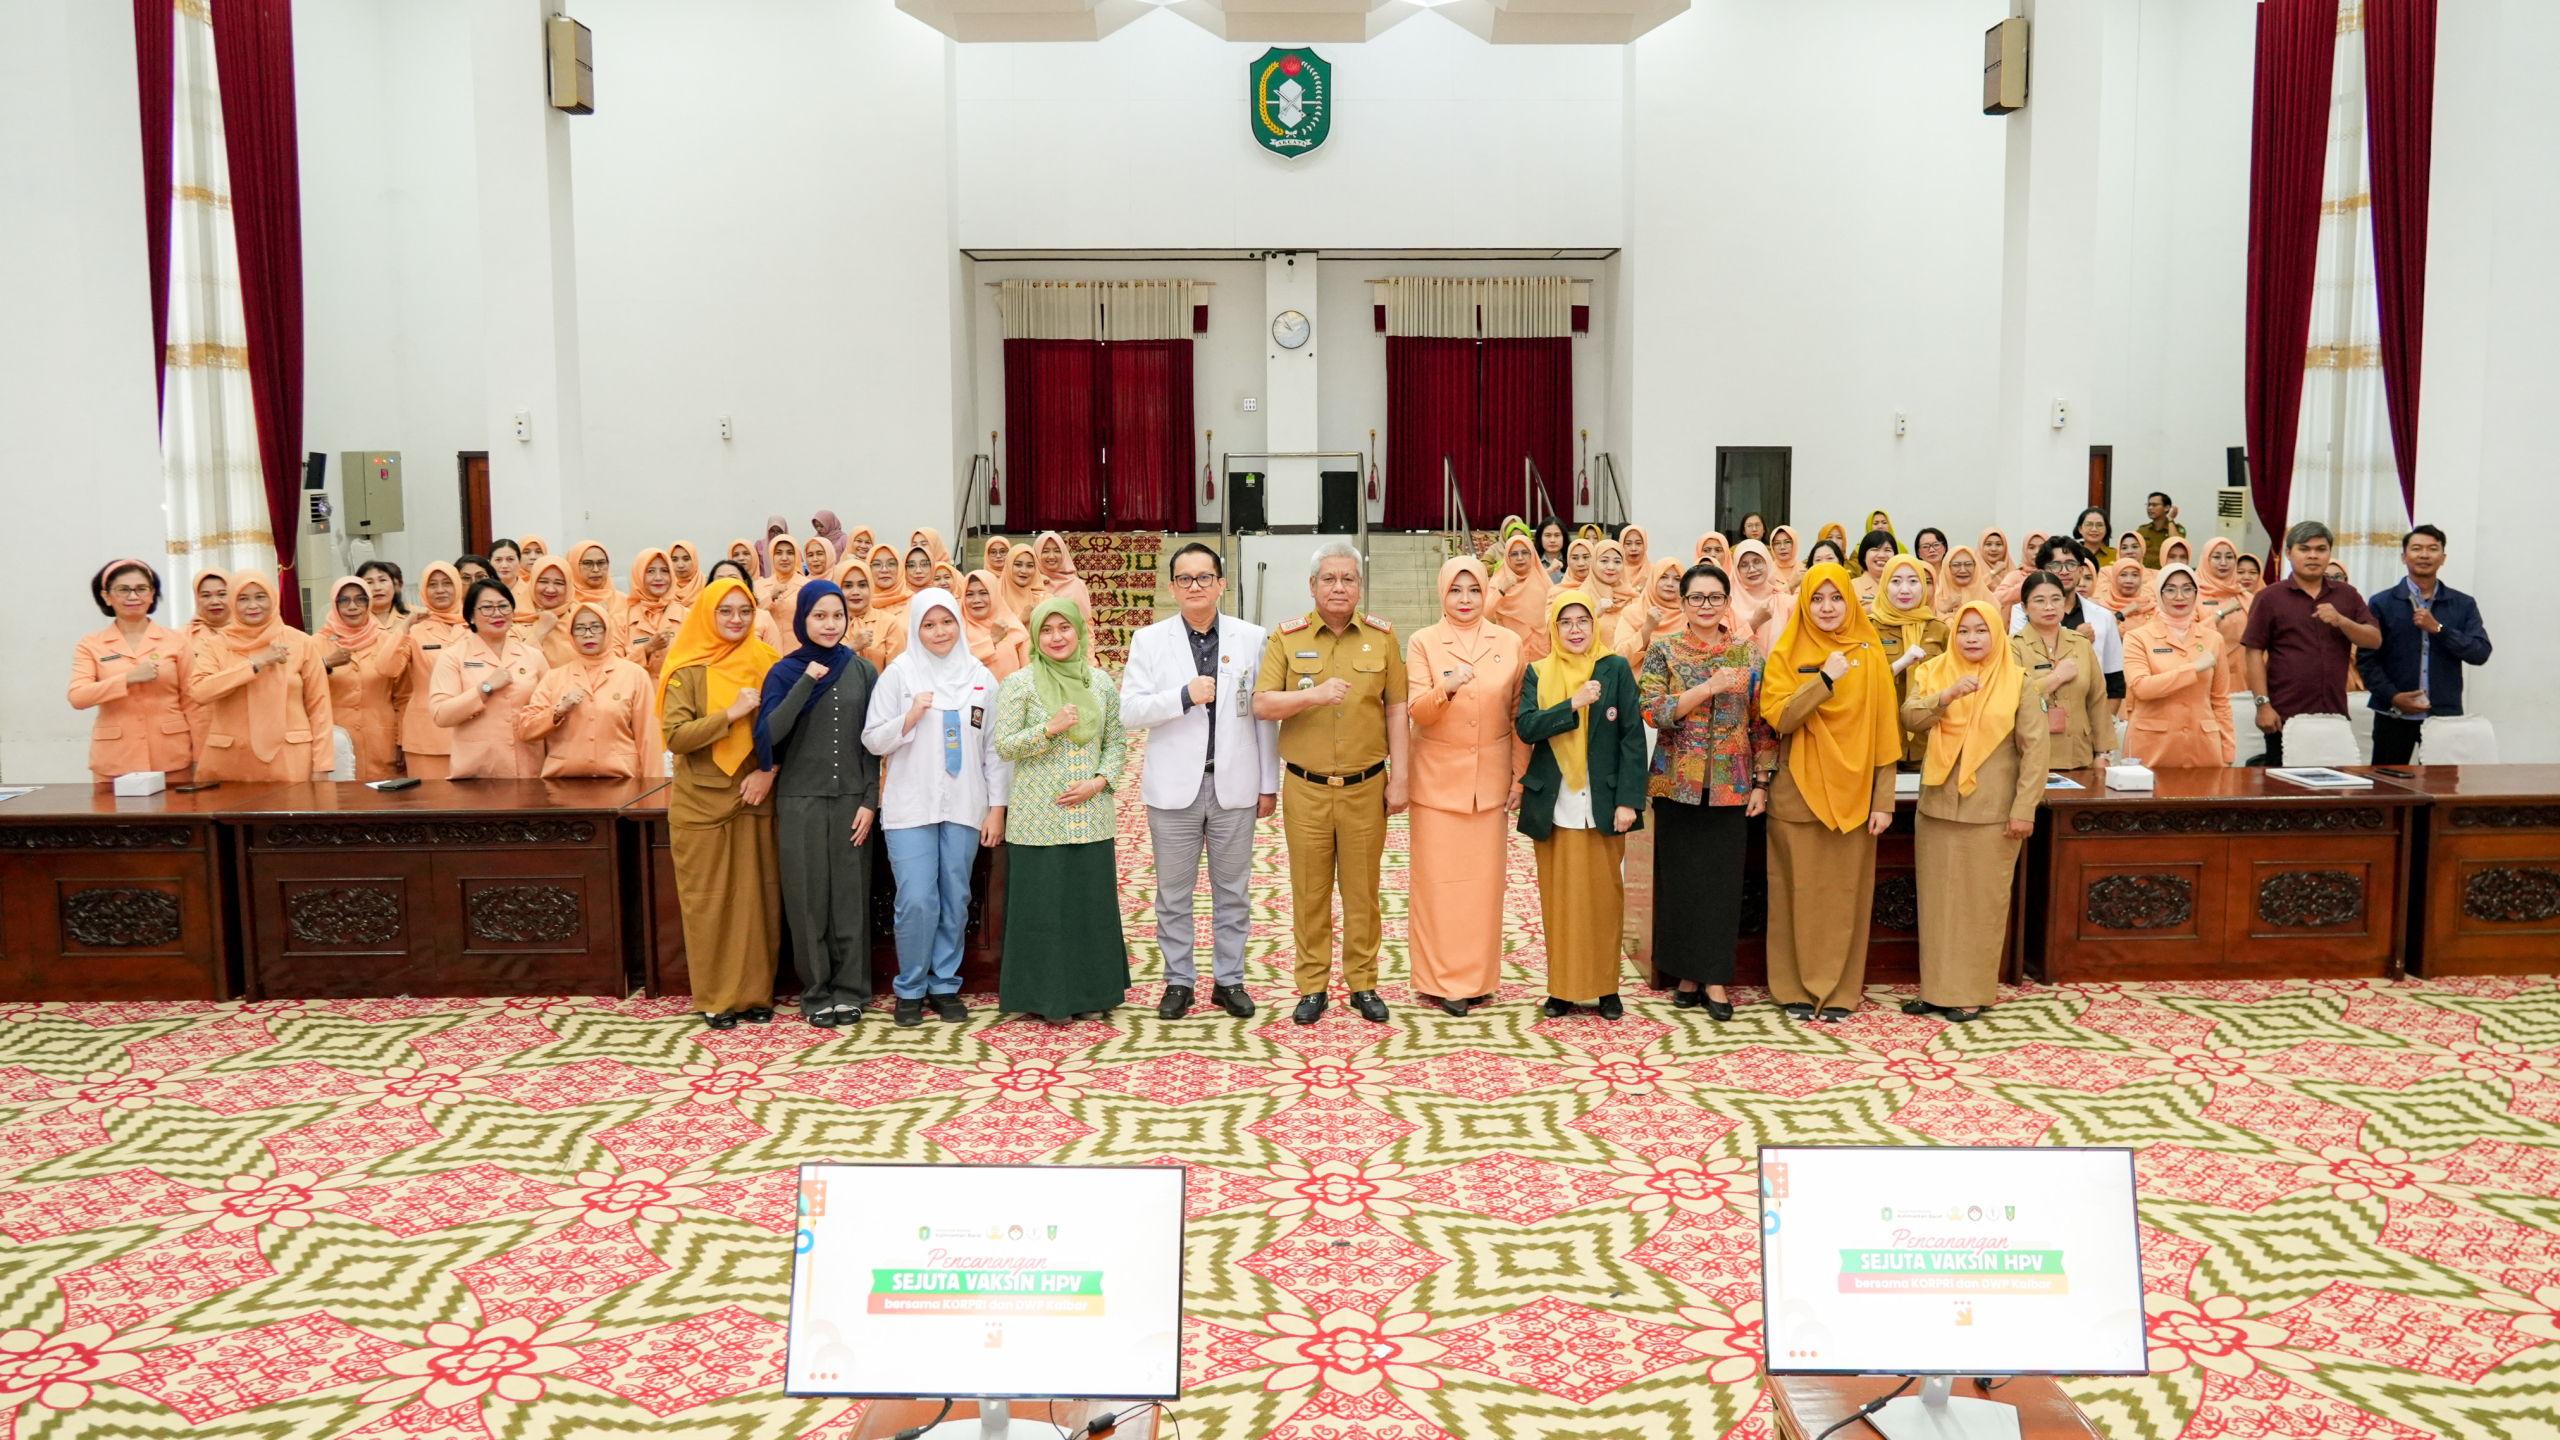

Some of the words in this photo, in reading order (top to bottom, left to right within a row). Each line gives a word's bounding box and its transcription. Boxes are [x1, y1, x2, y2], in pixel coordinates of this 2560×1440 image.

[1892, 1228, 2009, 1256] Pencanangan
[926, 1248, 1048, 1277] Pencanangan
[1861, 1253, 1926, 1270] SEJUTA
[1931, 1254, 1998, 1270] VAKSIN
[2004, 1254, 2043, 1271] HPV
[893, 1273, 960, 1290] SEJUTA
[966, 1273, 1034, 1291] VAKSIN
[1041, 1274, 1082, 1292] HPV
[1855, 1278, 1909, 1288] bersama
[1911, 1278, 1954, 1288] KORPRI
[1956, 1278, 1980, 1289] dan
[1982, 1279, 2010, 1289] DWP
[2012, 1279, 2051, 1289] Kalbar
[884, 1298, 940, 1309] bersama
[942, 1299, 987, 1310] KORPRI
[989, 1299, 1013, 1310] dan
[1015, 1300, 1044, 1310] DWP
[1046, 1300, 1088, 1311] Kalbar
